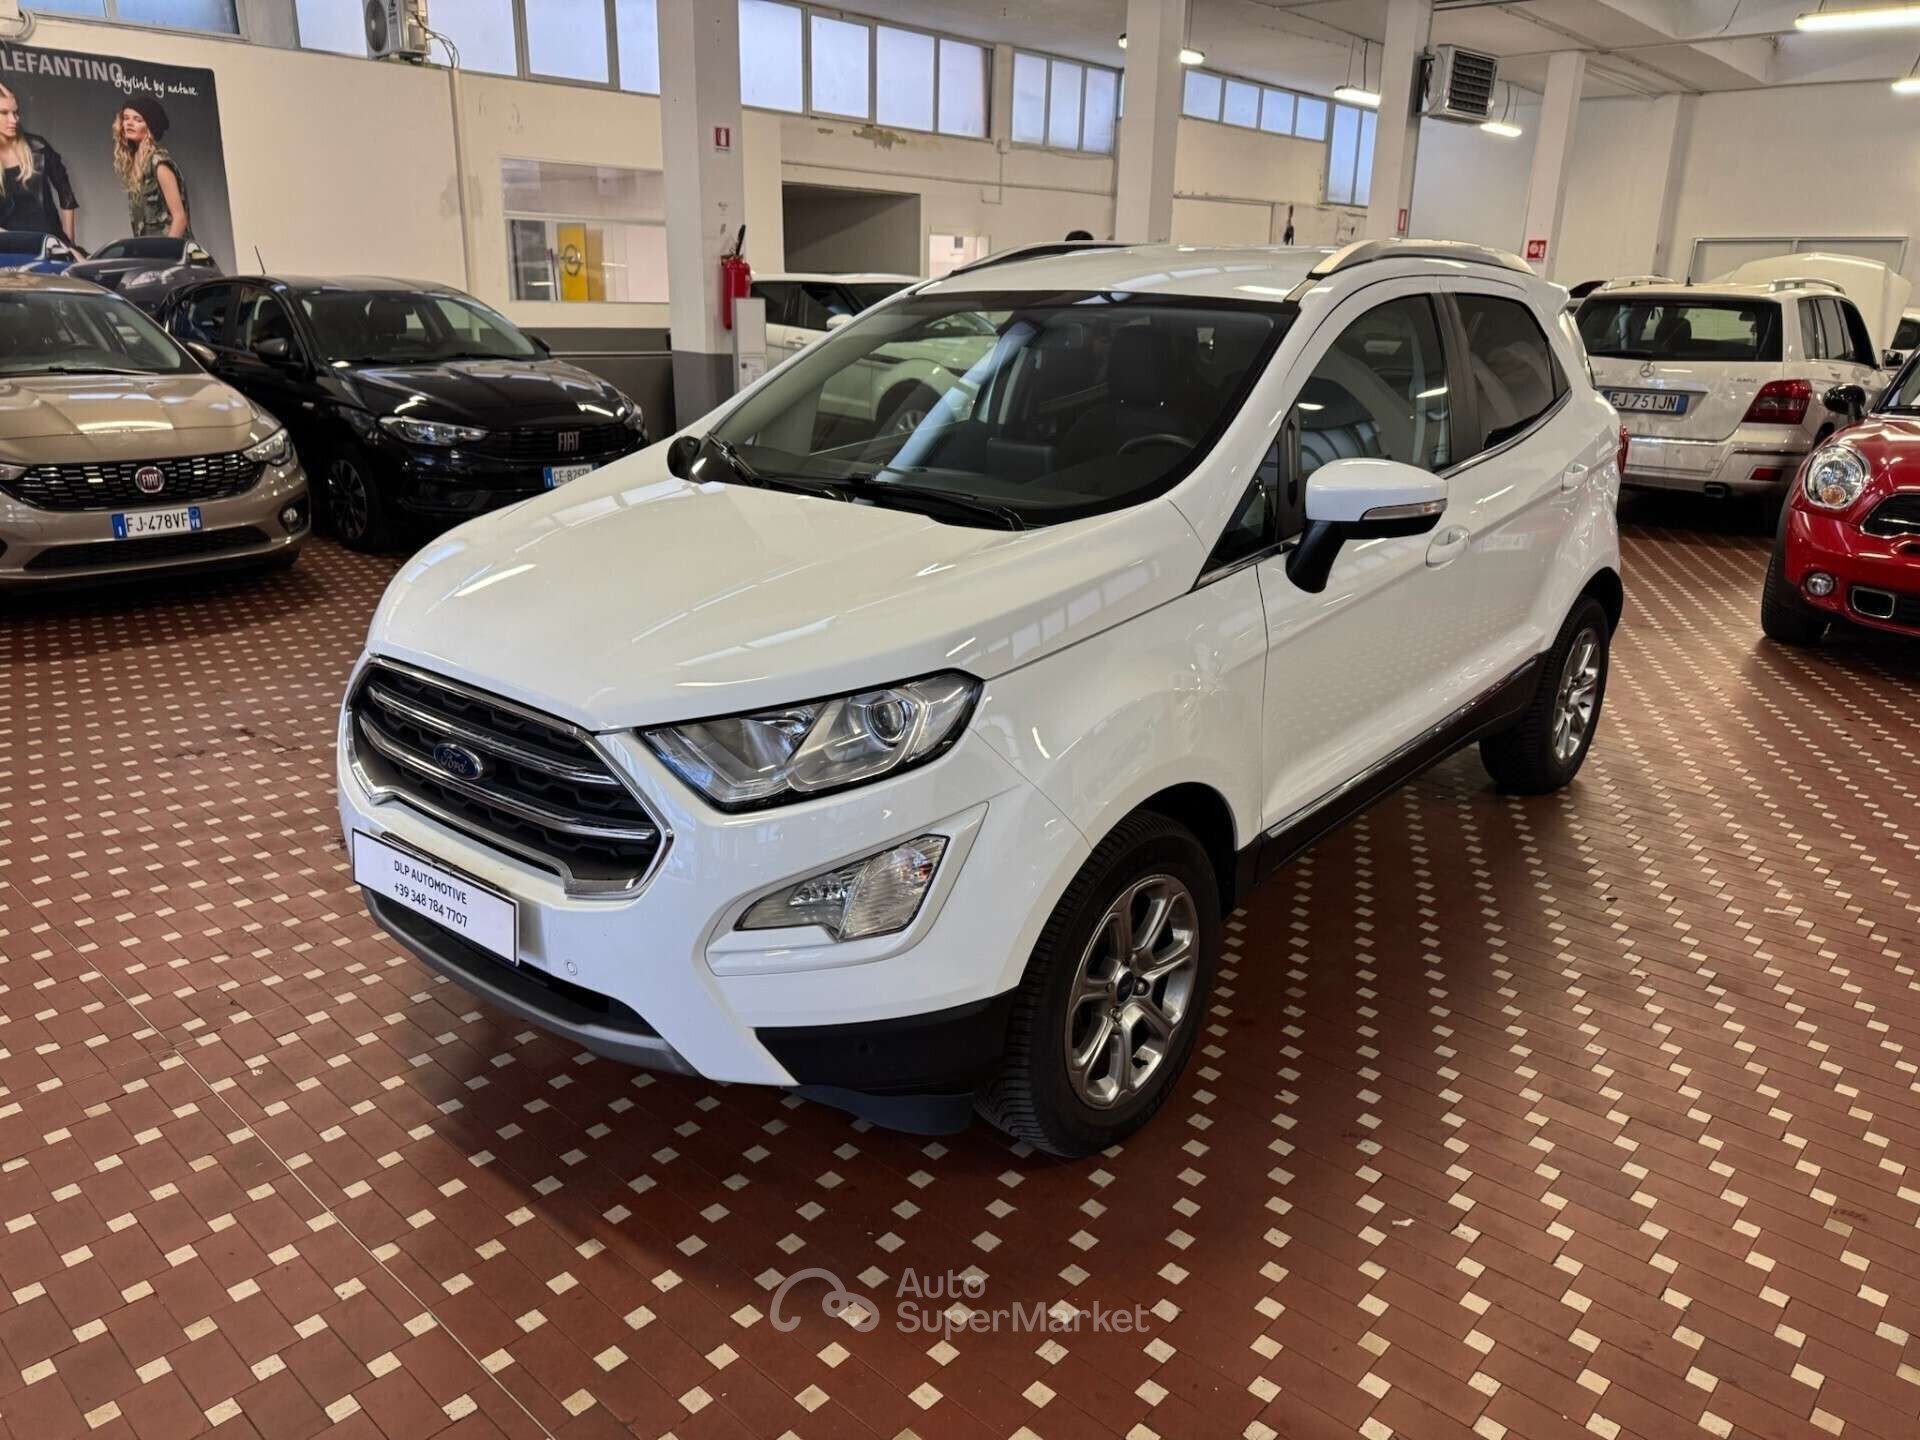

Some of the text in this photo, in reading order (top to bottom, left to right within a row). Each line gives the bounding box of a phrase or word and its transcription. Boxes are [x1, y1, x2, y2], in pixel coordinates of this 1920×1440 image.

[153, 80, 165, 98] by
[557, 431, 580, 452] FIAT
[141, 473, 159, 489] FIAT
[394, 860, 467, 905] DLP AUTOMOTIVE
[394, 882, 467, 928] +39 348 784 7707
